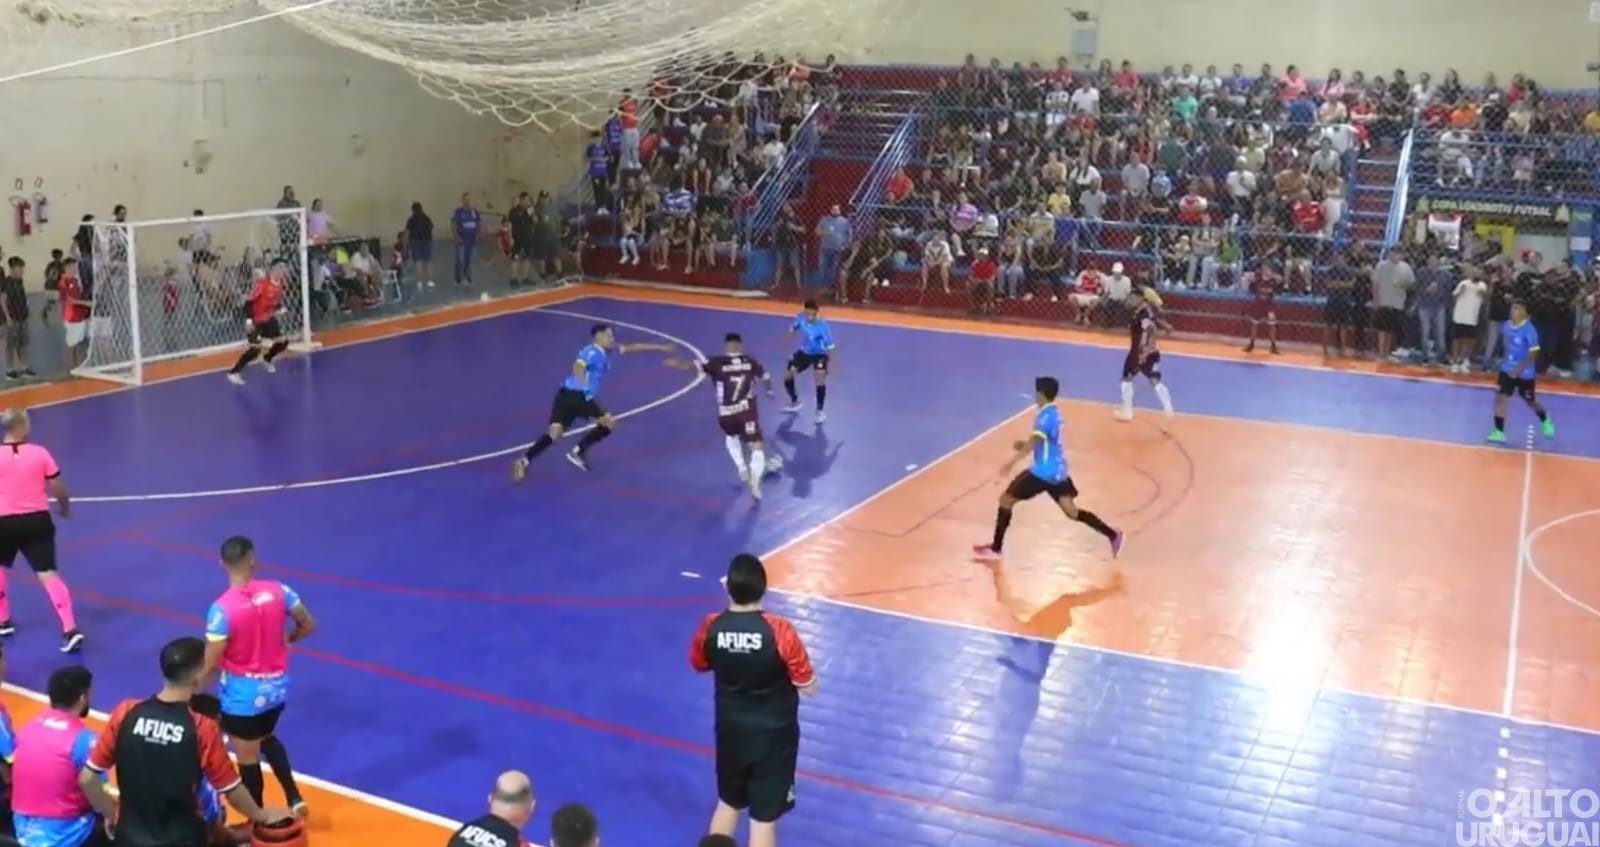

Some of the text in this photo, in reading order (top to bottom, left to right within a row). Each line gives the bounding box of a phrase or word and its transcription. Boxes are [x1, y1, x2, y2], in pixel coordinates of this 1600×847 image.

[1431, 200, 1457, 210] COPA
[1514, 205, 1552, 216] FUTSAL
[730, 374, 746, 402] 7
[717, 632, 762, 650] AFUCS
[132, 717, 184, 743] AFUCS
